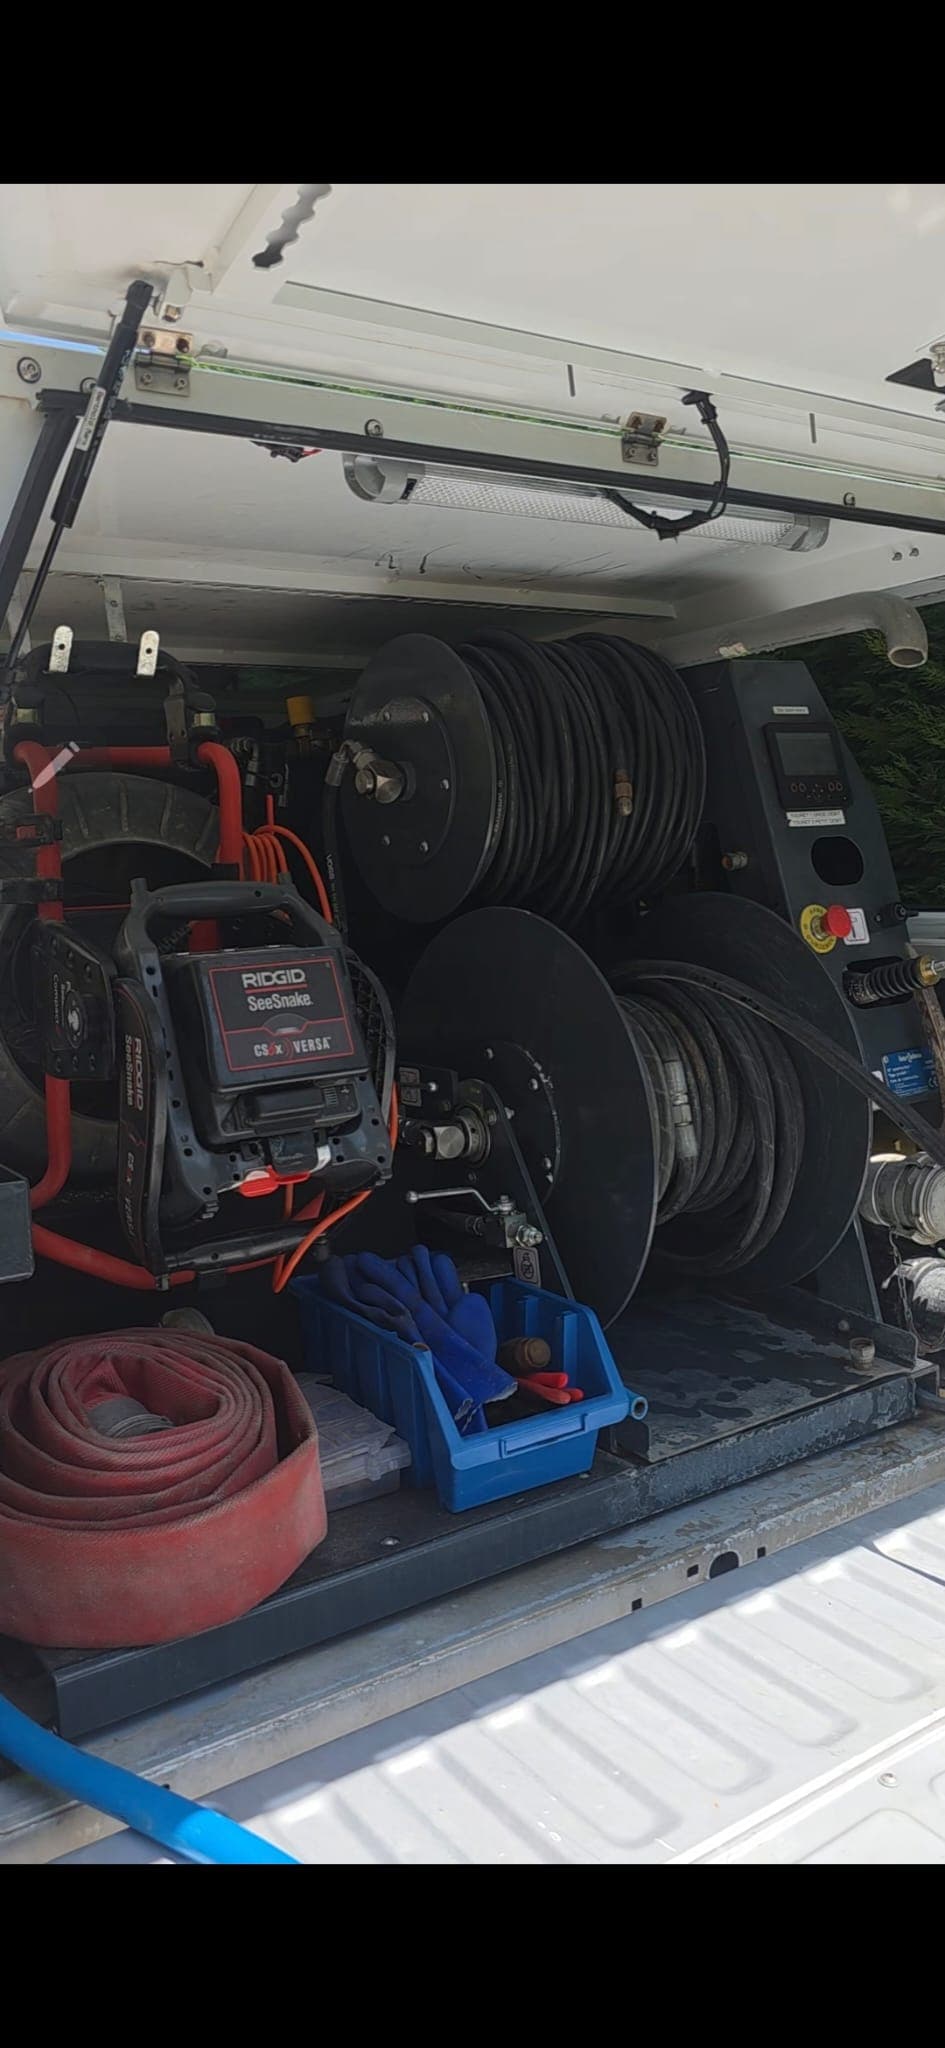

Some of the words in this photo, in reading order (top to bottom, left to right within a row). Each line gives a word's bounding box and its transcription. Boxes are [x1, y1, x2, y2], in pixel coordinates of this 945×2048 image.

[241, 968, 306, 989] RIDGID
[248, 991, 313, 1012] SeeSnake
[124, 1034, 134, 1106] SeeSnake
[135, 1037, 144, 1112] RIDGID
